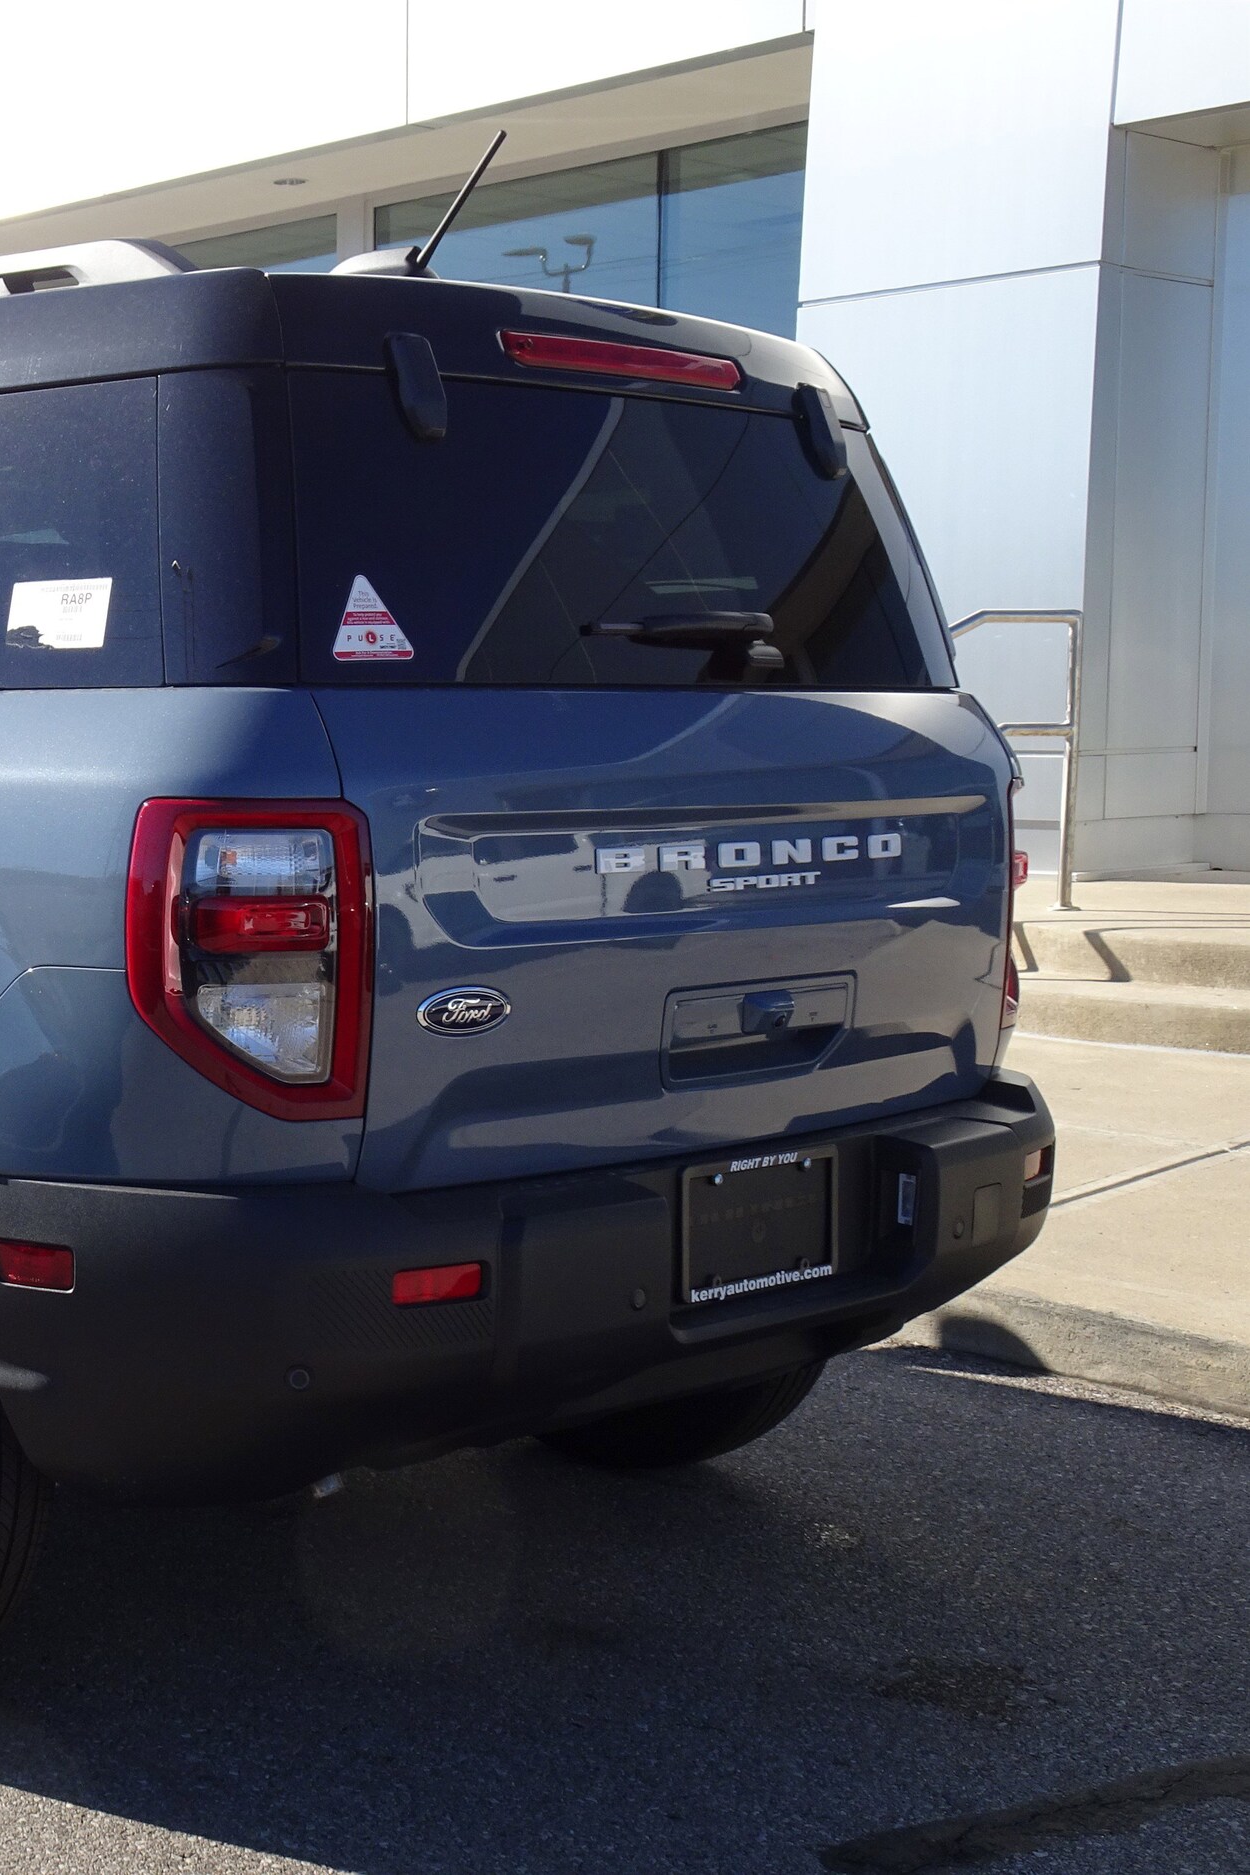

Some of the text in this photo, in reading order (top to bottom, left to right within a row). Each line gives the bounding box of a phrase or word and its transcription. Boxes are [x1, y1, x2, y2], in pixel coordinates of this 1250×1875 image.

[61, 592, 92, 606] RA8P
[595, 832, 902, 873] BRONCO
[709, 871, 821, 892] SPORT
[441, 998, 492, 1024] Ford
[730, 1152, 798, 1173] RIGHT BY YOU
[691, 1264, 833, 1303] kerryautomotive.com
